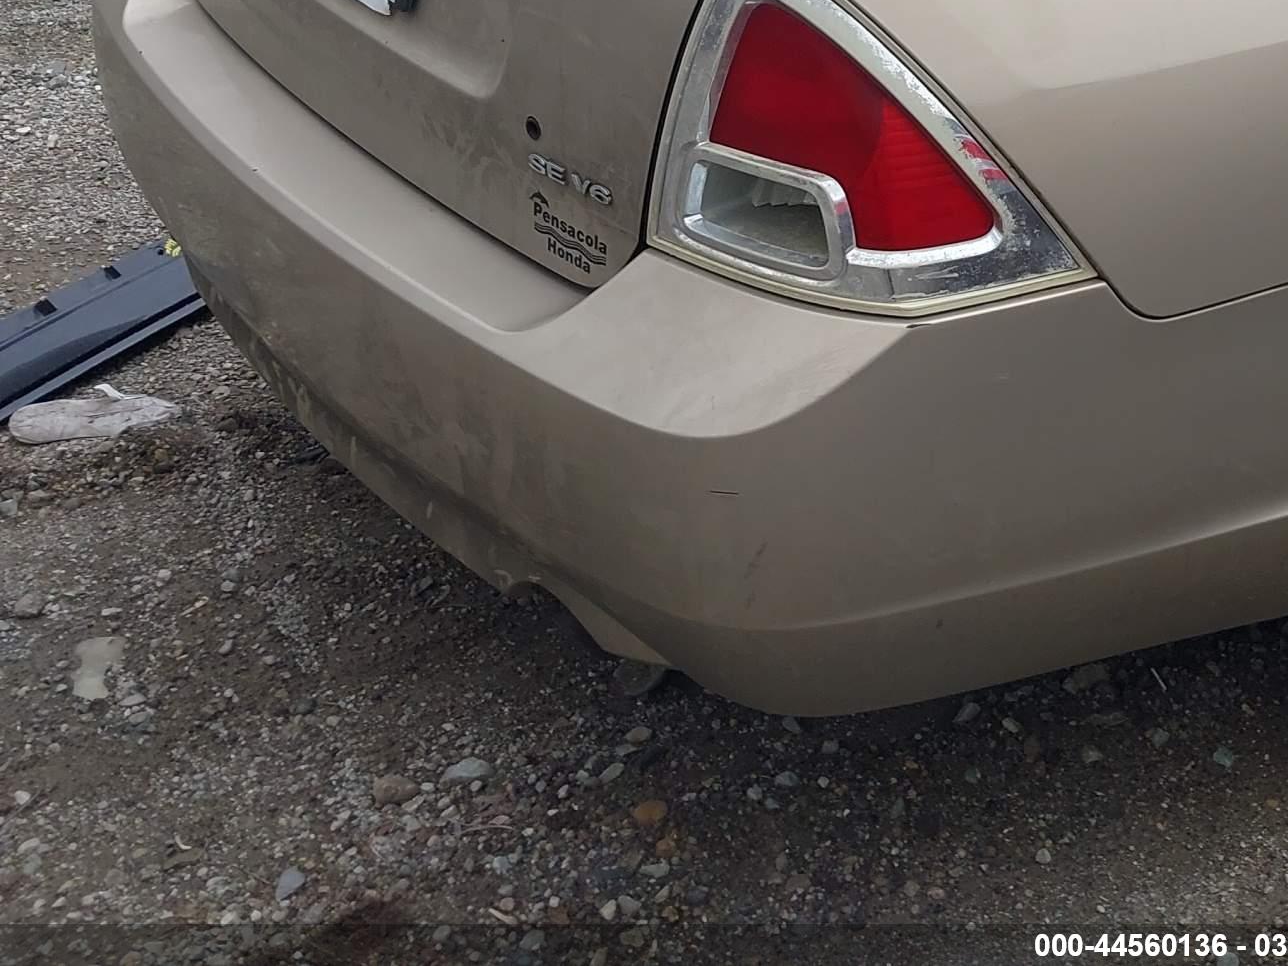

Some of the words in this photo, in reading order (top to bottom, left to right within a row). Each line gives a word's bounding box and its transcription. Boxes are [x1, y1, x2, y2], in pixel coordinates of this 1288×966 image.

[527, 153, 567, 185] SE
[571, 172, 614, 206] V6
[533, 201, 608, 255] Pensacola
[547, 237, 592, 275] Honda
